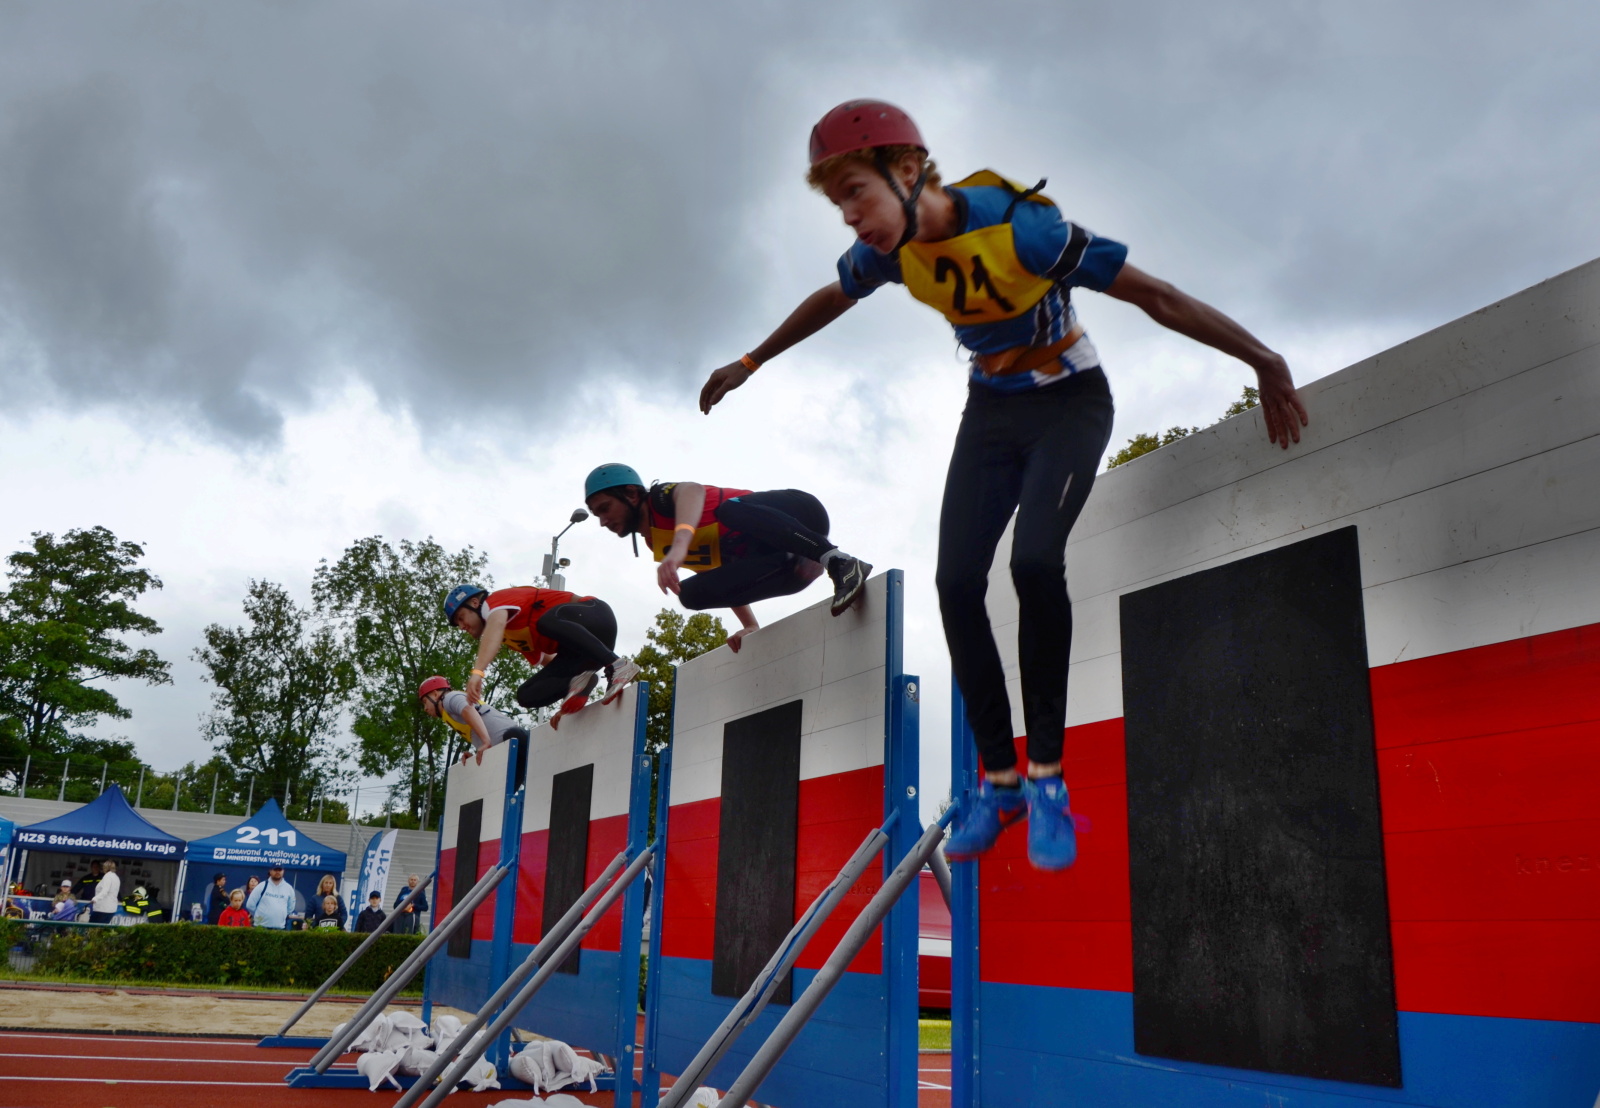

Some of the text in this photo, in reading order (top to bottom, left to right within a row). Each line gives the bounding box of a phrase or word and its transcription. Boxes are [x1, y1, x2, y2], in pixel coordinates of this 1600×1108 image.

[934, 254, 1016, 315] 21
[18, 832, 177, 855] HZS Středočeského kraje
[236, 826, 296, 847] 211
[226, 855, 268, 863] MINISTERSTVA
[300, 854, 321, 867] 211
[227, 848, 262, 856] ZDRAVOTNÍ
[377, 849, 390, 876] 211
